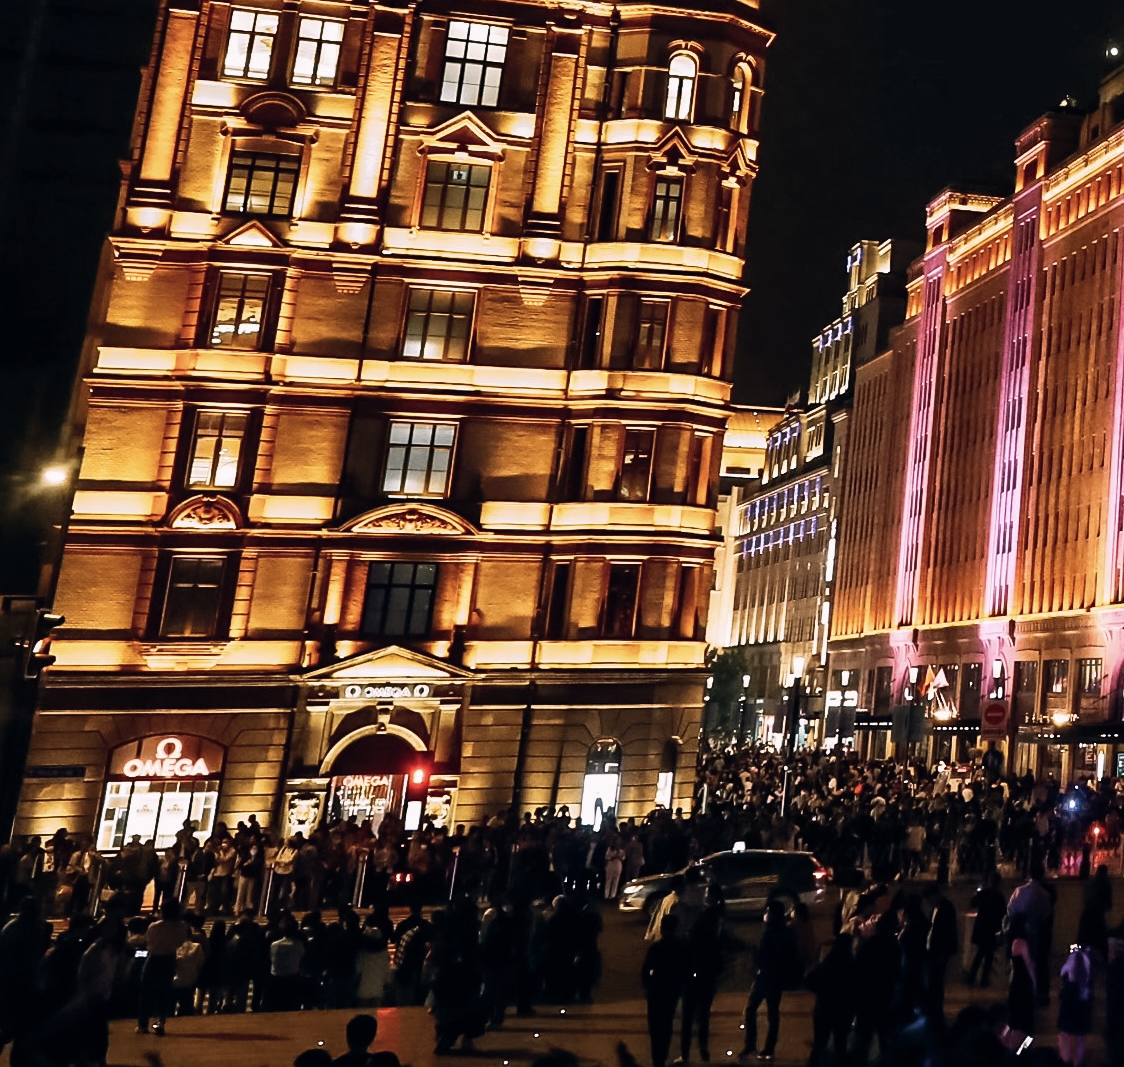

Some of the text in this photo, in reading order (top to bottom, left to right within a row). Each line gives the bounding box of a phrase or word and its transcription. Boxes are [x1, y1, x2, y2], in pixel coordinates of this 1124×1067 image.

[364, 687, 411, 698] OMEGA
[123, 757, 210, 777] OMEGA
[343, 776, 390, 787] OMEGA
